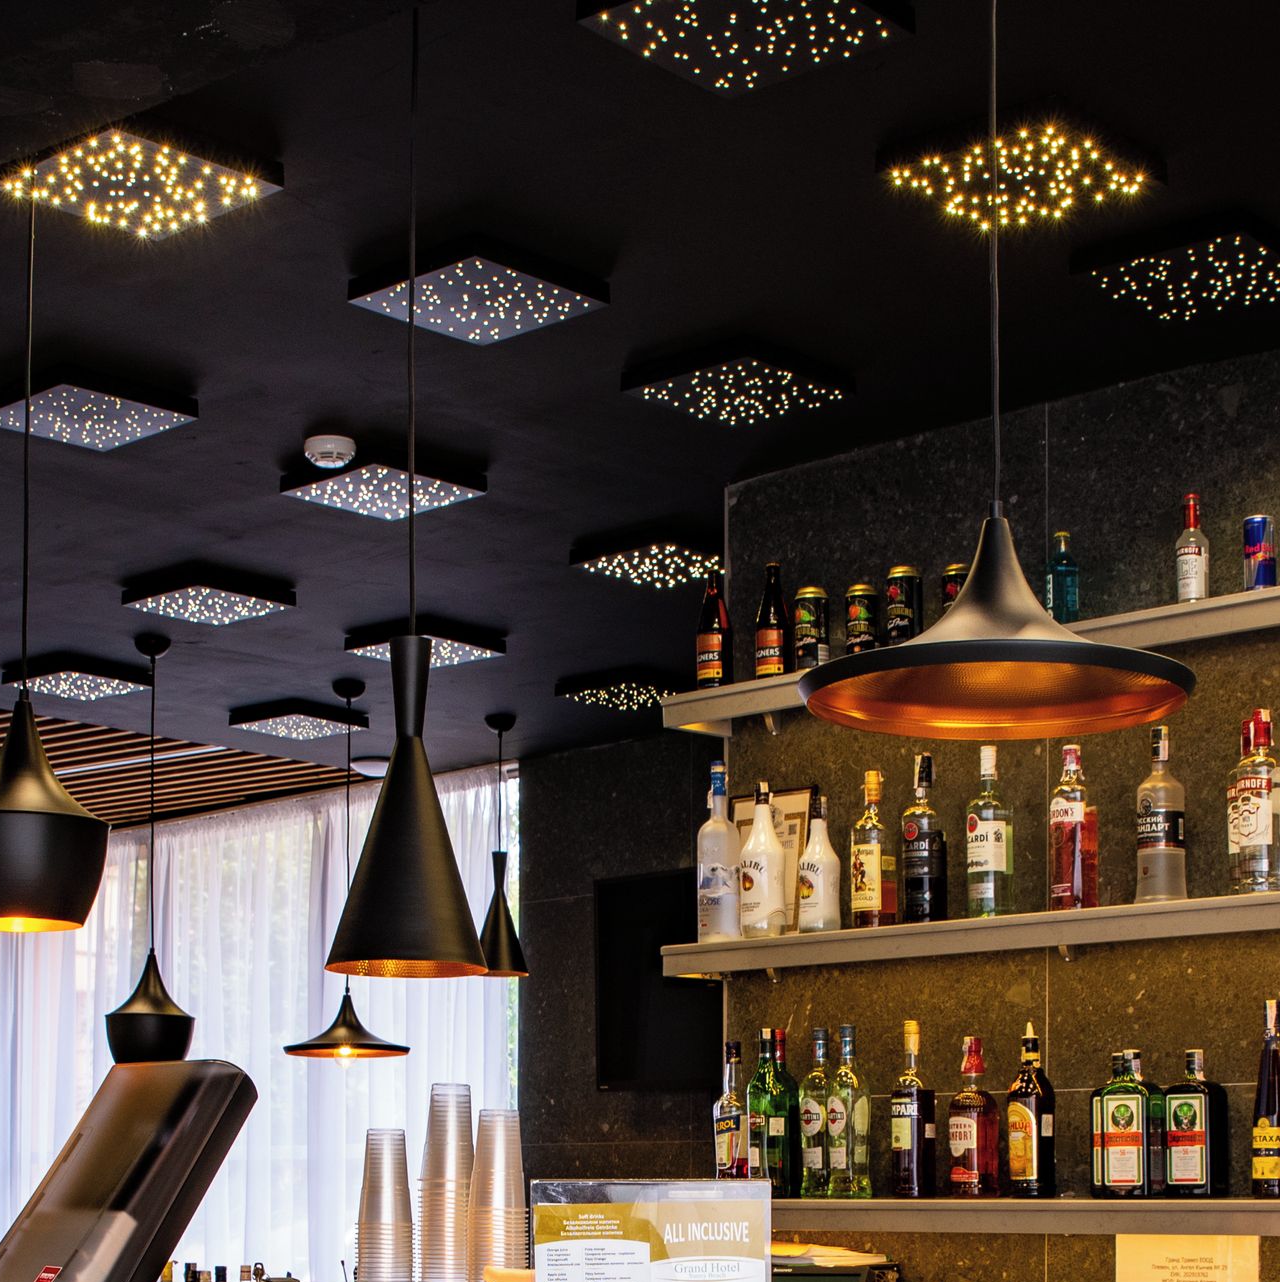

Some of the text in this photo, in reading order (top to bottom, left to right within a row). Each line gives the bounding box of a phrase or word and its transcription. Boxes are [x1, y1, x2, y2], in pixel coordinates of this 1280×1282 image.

[698, 652, 719, 663] GNERS
[756, 647, 780, 658] GNERS
[1237, 779, 1268, 789] IRNOFF
[1051, 807, 1074, 819] RDON'S
[1137, 823, 1170, 832] АНДАРТ
[968, 832, 989, 842] CARDÍ
[905, 839, 929, 850] CARDÍ
[892, 1104, 919, 1116] MPARI
[716, 1119, 736, 1131] EROL
[950, 1130, 972, 1141] MFORT
[663, 1221, 750, 1245] ALL INCLUSIVE
[674, 1262, 740, 1274] Grand Hotel
